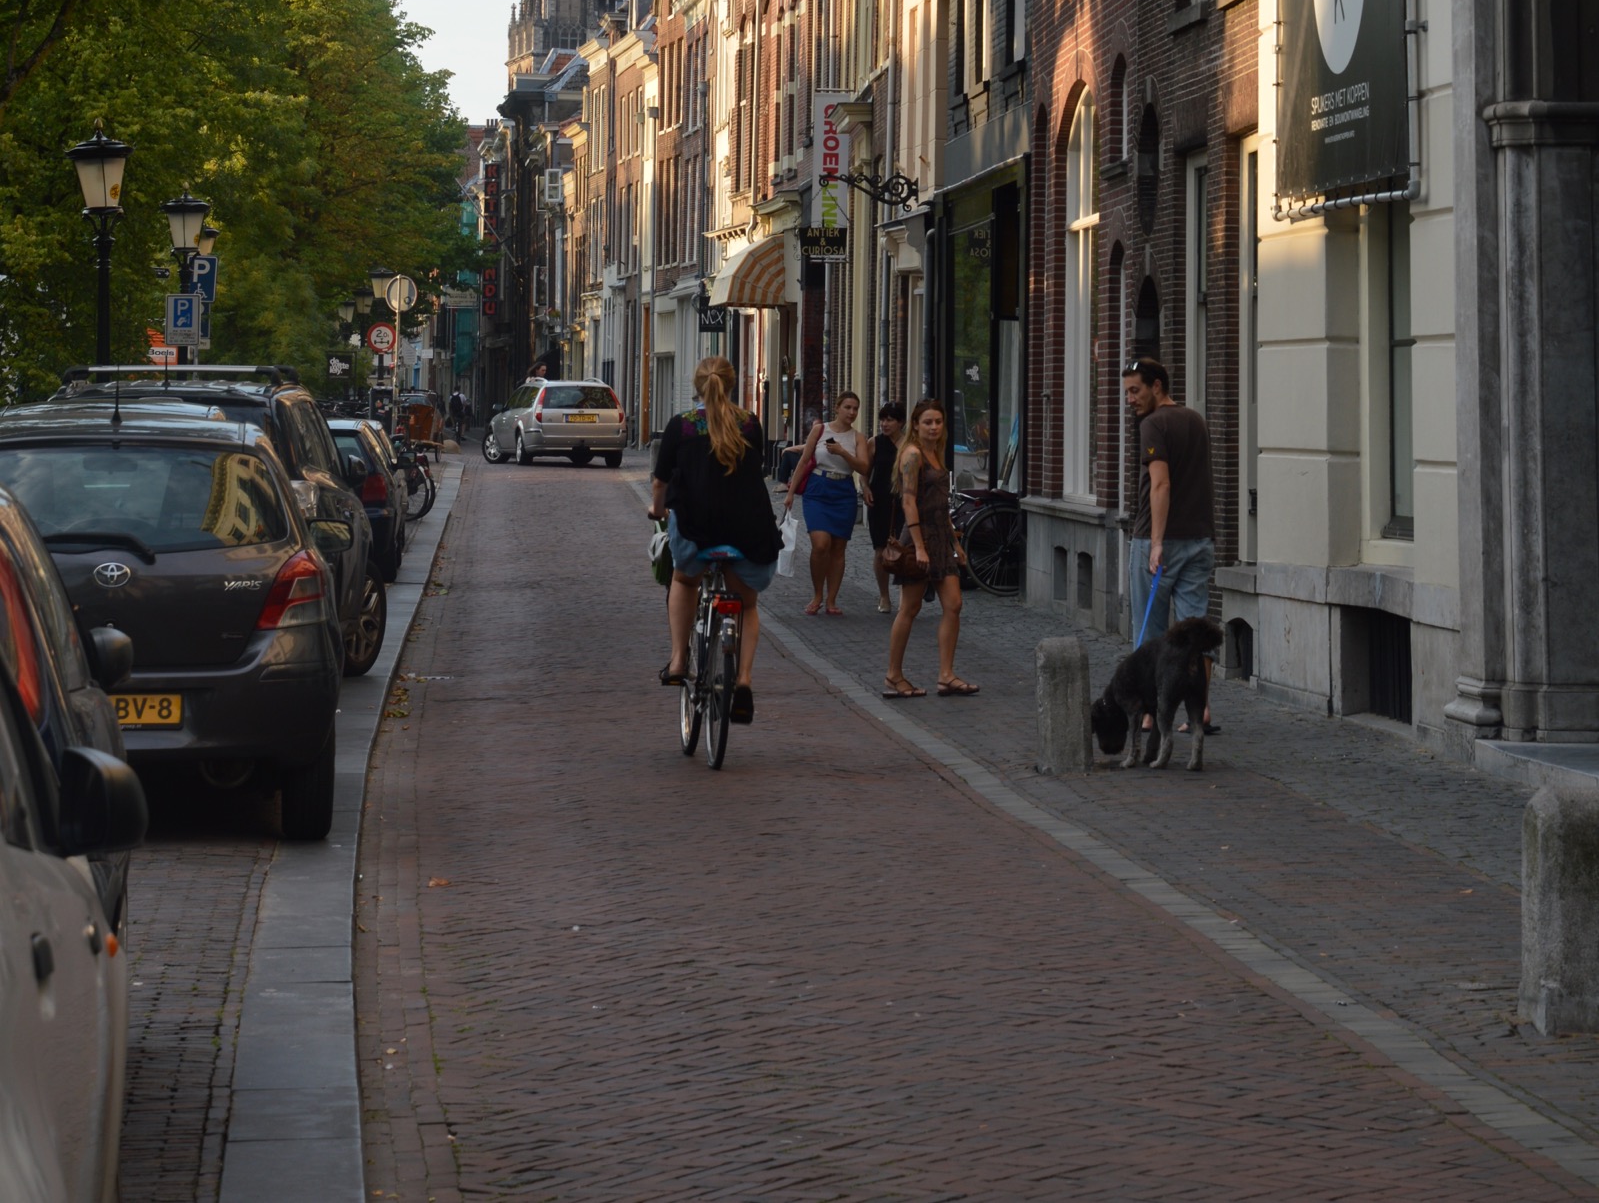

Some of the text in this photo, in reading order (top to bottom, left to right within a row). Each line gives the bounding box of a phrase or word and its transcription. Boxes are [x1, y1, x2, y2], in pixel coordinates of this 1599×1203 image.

[1335, 88, 1346, 109] MET
[1346, 81, 1370, 105] KOPPEN
[821, 103, 840, 229] GROENLINK
[806, 228, 840, 237] ANTIEK
[819, 237, 827, 246] &
[801, 245, 846, 256] CURIOSA
[192, 259, 211, 283] P
[177, 300, 190, 316] P
[114, 697, 173, 720] BV-8
